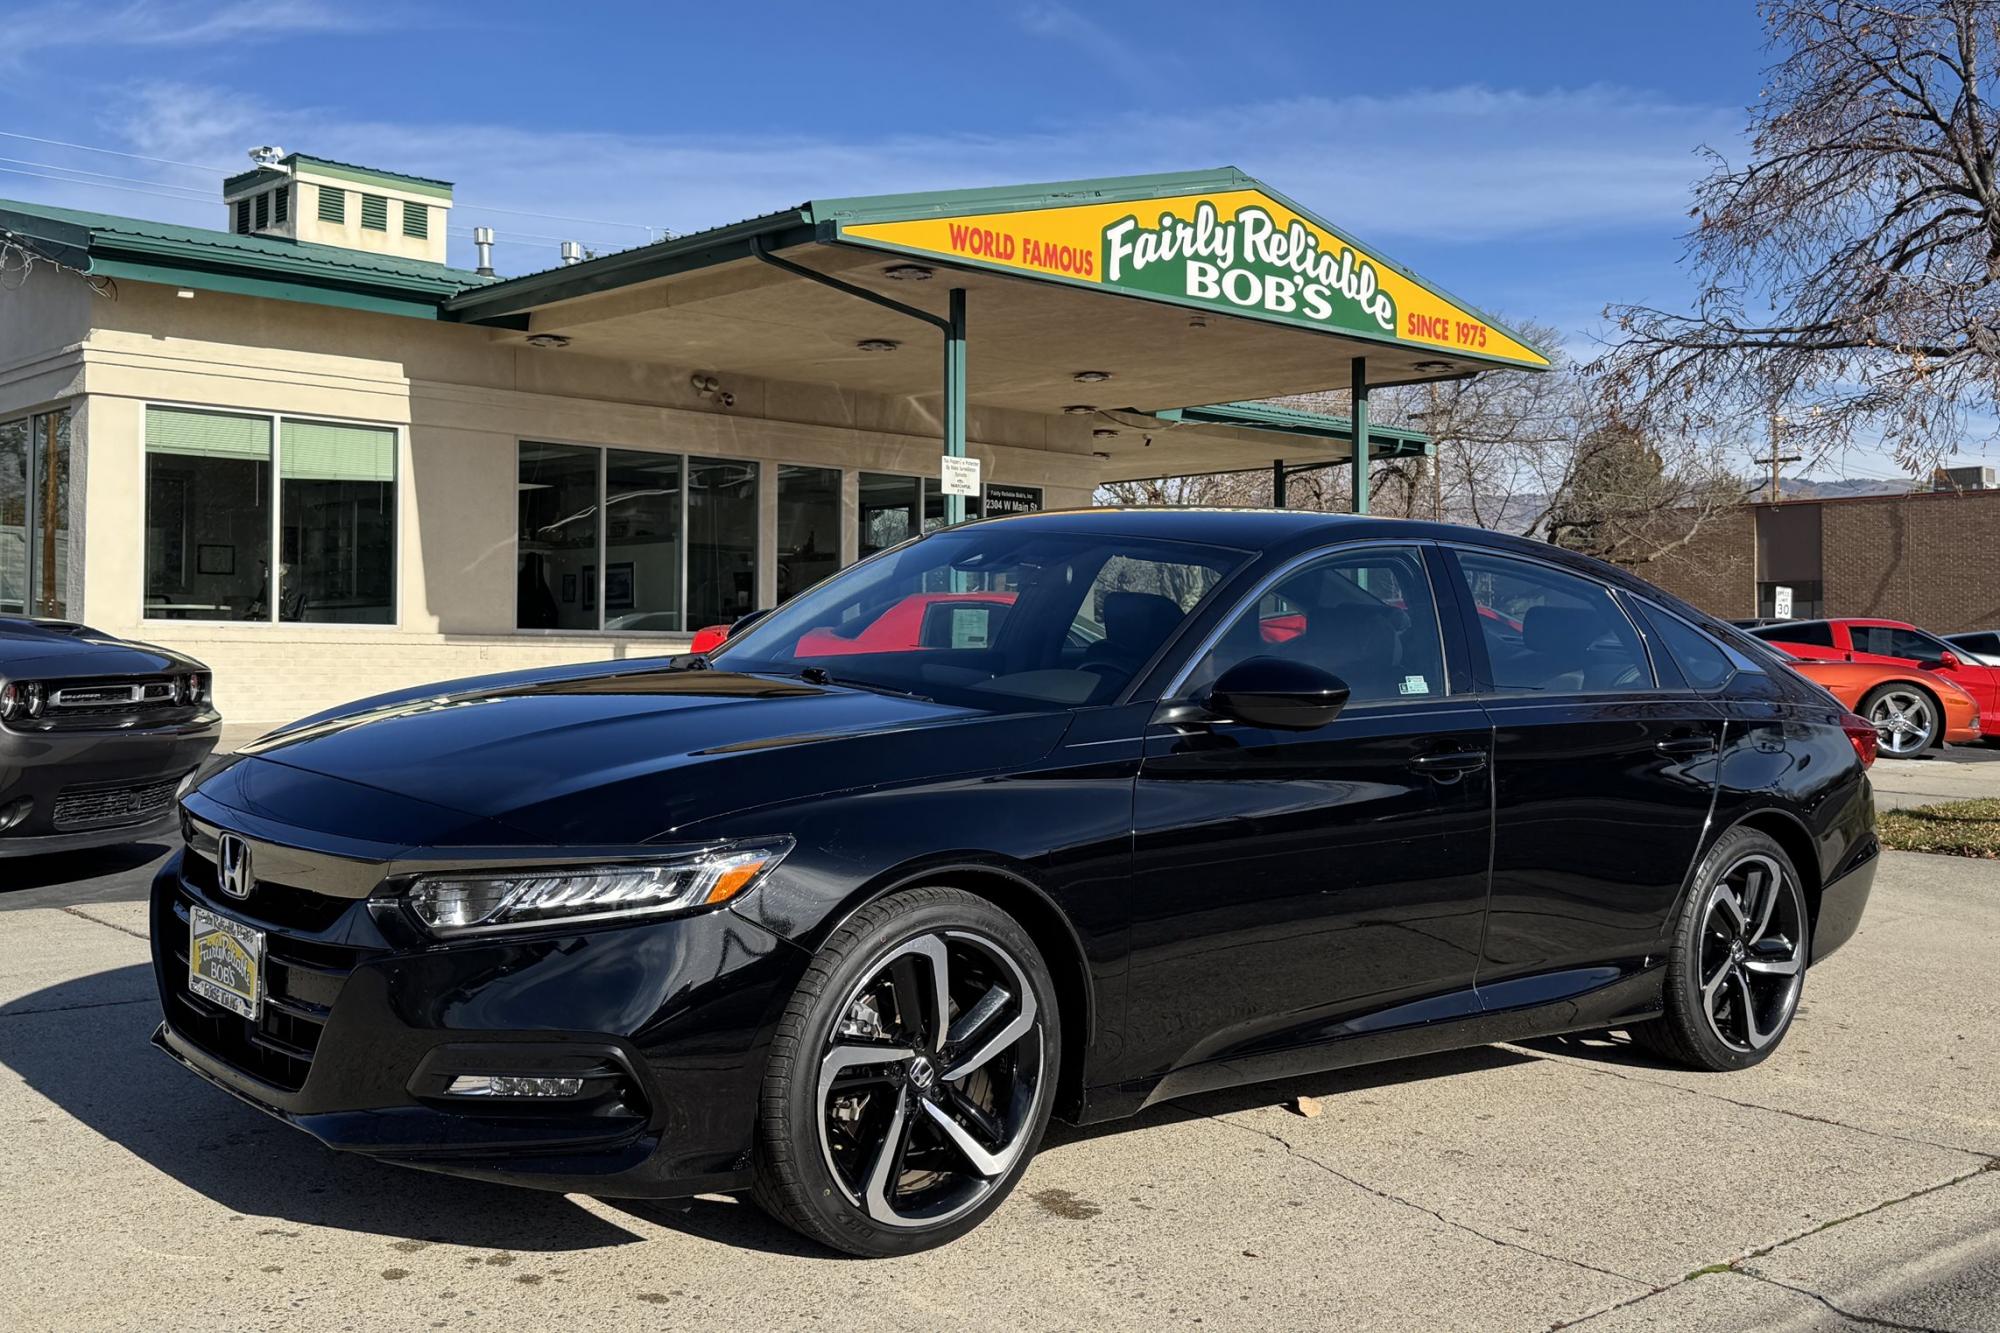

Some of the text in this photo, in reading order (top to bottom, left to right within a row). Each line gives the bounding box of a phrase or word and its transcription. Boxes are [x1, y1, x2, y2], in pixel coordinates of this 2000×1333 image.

[949, 223, 1093, 276] WORLD FAMOUS
[1106, 204, 1395, 330] Fairly Reliable
[1186, 259, 1333, 320] BOB'S
[1408, 312, 1487, 348] SINCE 1975
[986, 500, 1003, 510] 2304
[1003, 500, 1011, 511] W
[1012, 501, 1029, 513] Main
[1777, 603, 1790, 615] 30
[199, 935, 251, 986] Fairly Reliable
[210, 961, 236, 987] BOB'S
